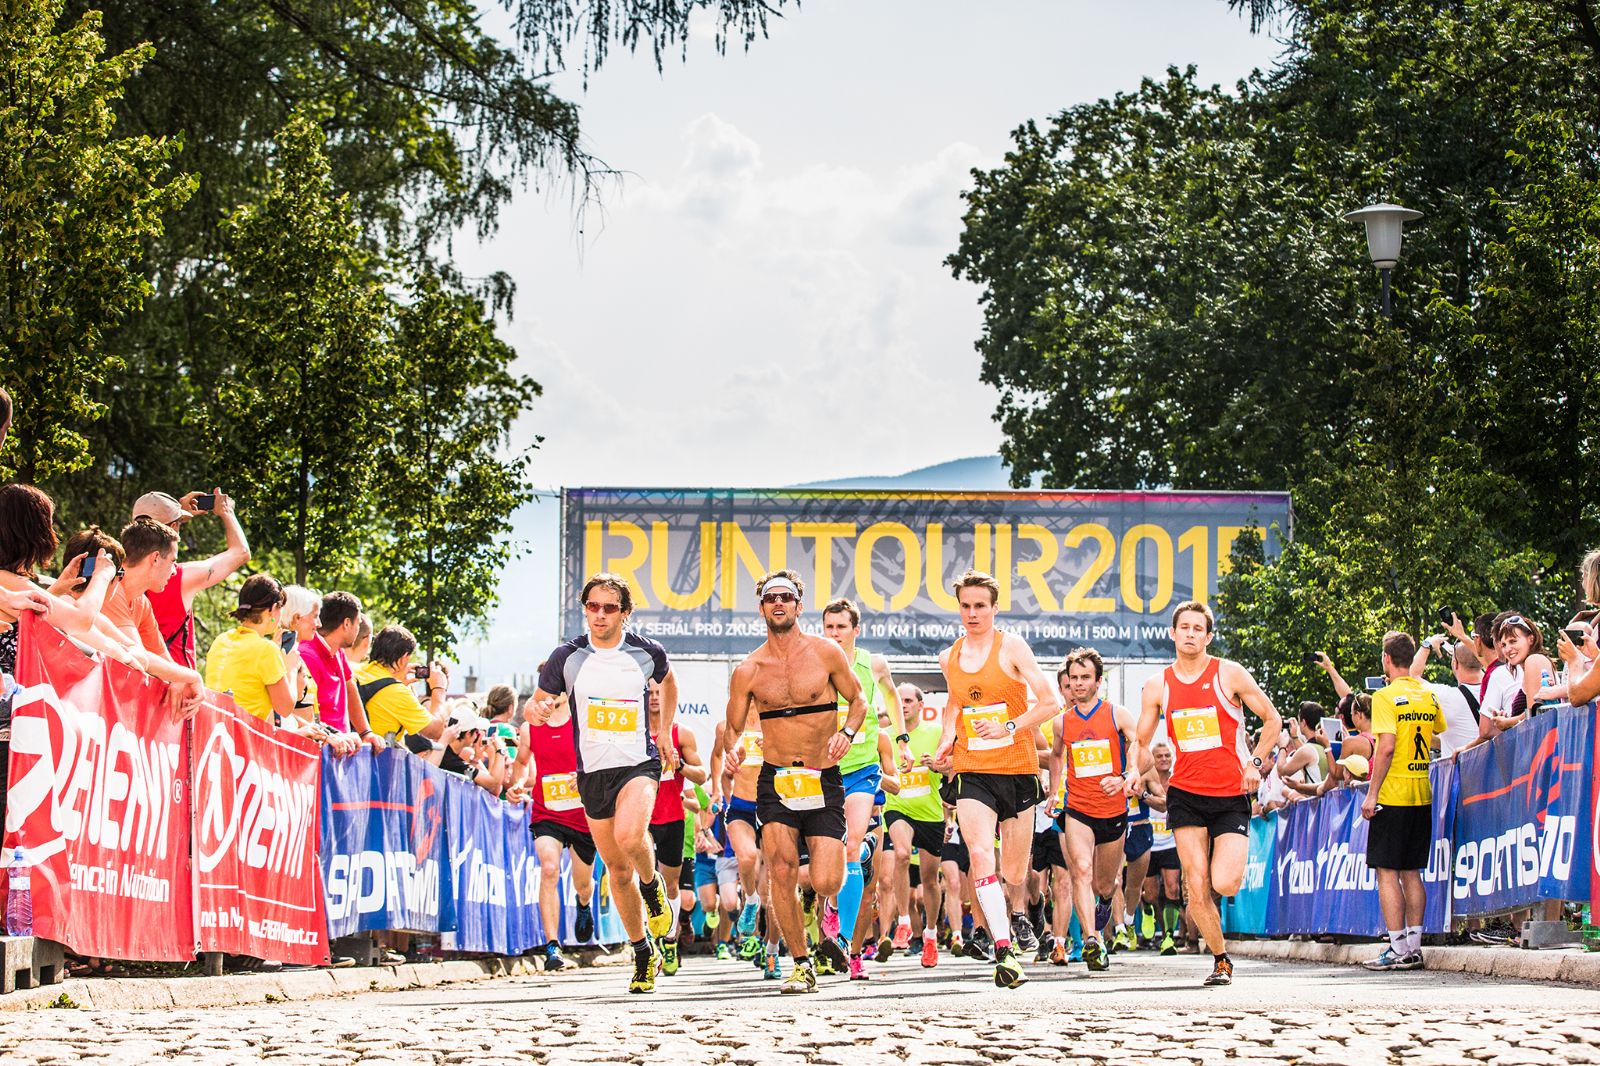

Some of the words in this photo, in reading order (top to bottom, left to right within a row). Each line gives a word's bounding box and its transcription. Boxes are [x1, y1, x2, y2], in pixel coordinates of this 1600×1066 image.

[646, 620, 692, 636] SERIÁL
[695, 622, 723, 636] PRO
[725, 619, 767, 637] ZKUŠE
[870, 624, 884, 637] 10
[888, 624, 910, 637] KM
[1069, 626, 1081, 638] M
[1092, 626, 1116, 639] 500
[1119, 626, 1131, 639] M
[596, 711, 628, 725] 596
[1398, 710, 1437, 722] PRŮVOD
[1186, 719, 1206, 733] 43
[1079, 750, 1103, 762] 361
[550, 783, 573, 796] 28
[793, 778, 802, 791] 9
